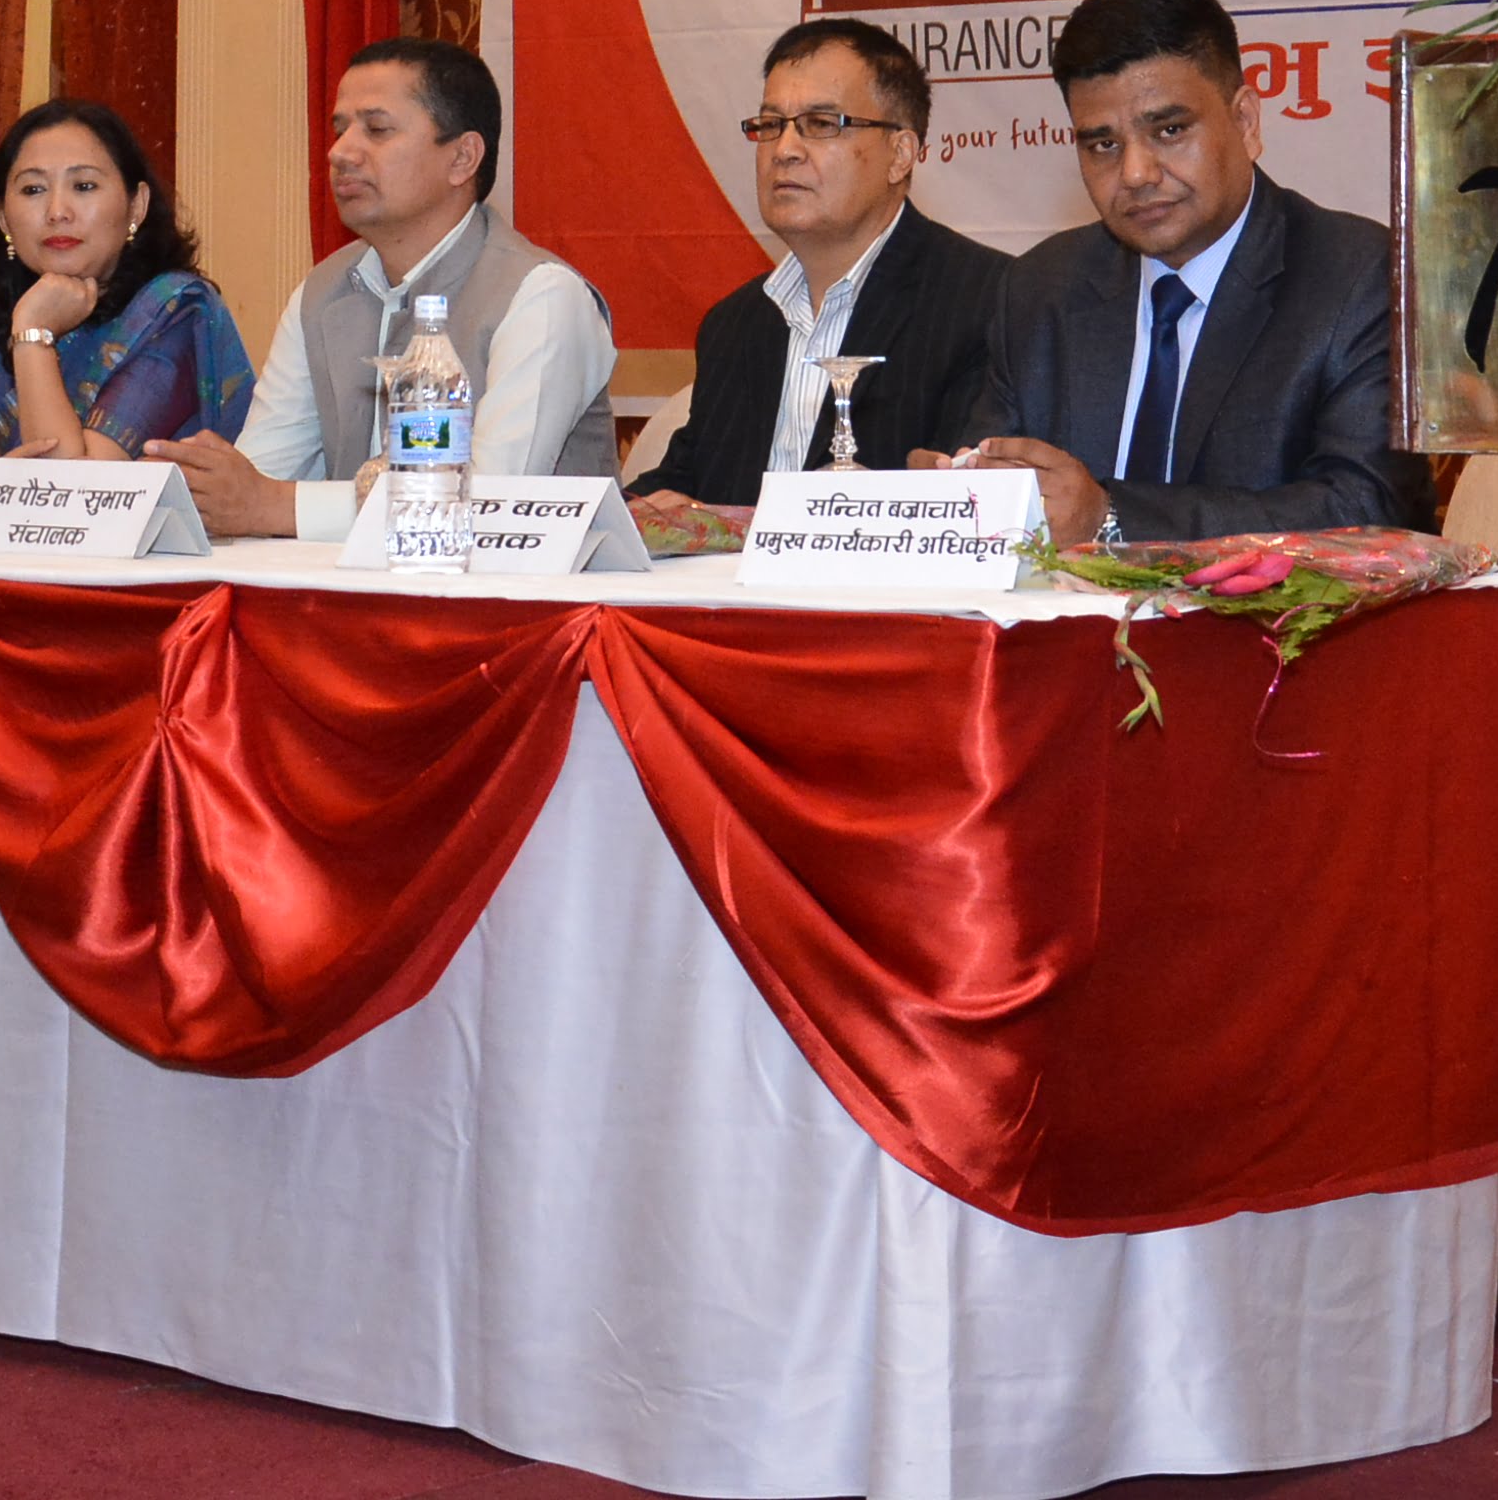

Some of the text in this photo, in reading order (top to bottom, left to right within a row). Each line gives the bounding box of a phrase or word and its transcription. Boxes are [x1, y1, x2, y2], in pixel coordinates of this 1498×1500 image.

[940, 129, 999, 163] your
[1010, 117, 1078, 150] futur
[18, 477, 74, 508] पौडेल
[806, 492, 885, 518] सन्चित
[512, 499, 589, 518] बल्ल
[8, 519, 90, 546] संचालक
[754, 528, 1009, 563] प्रमुख कार्यकारी अधिकृत
